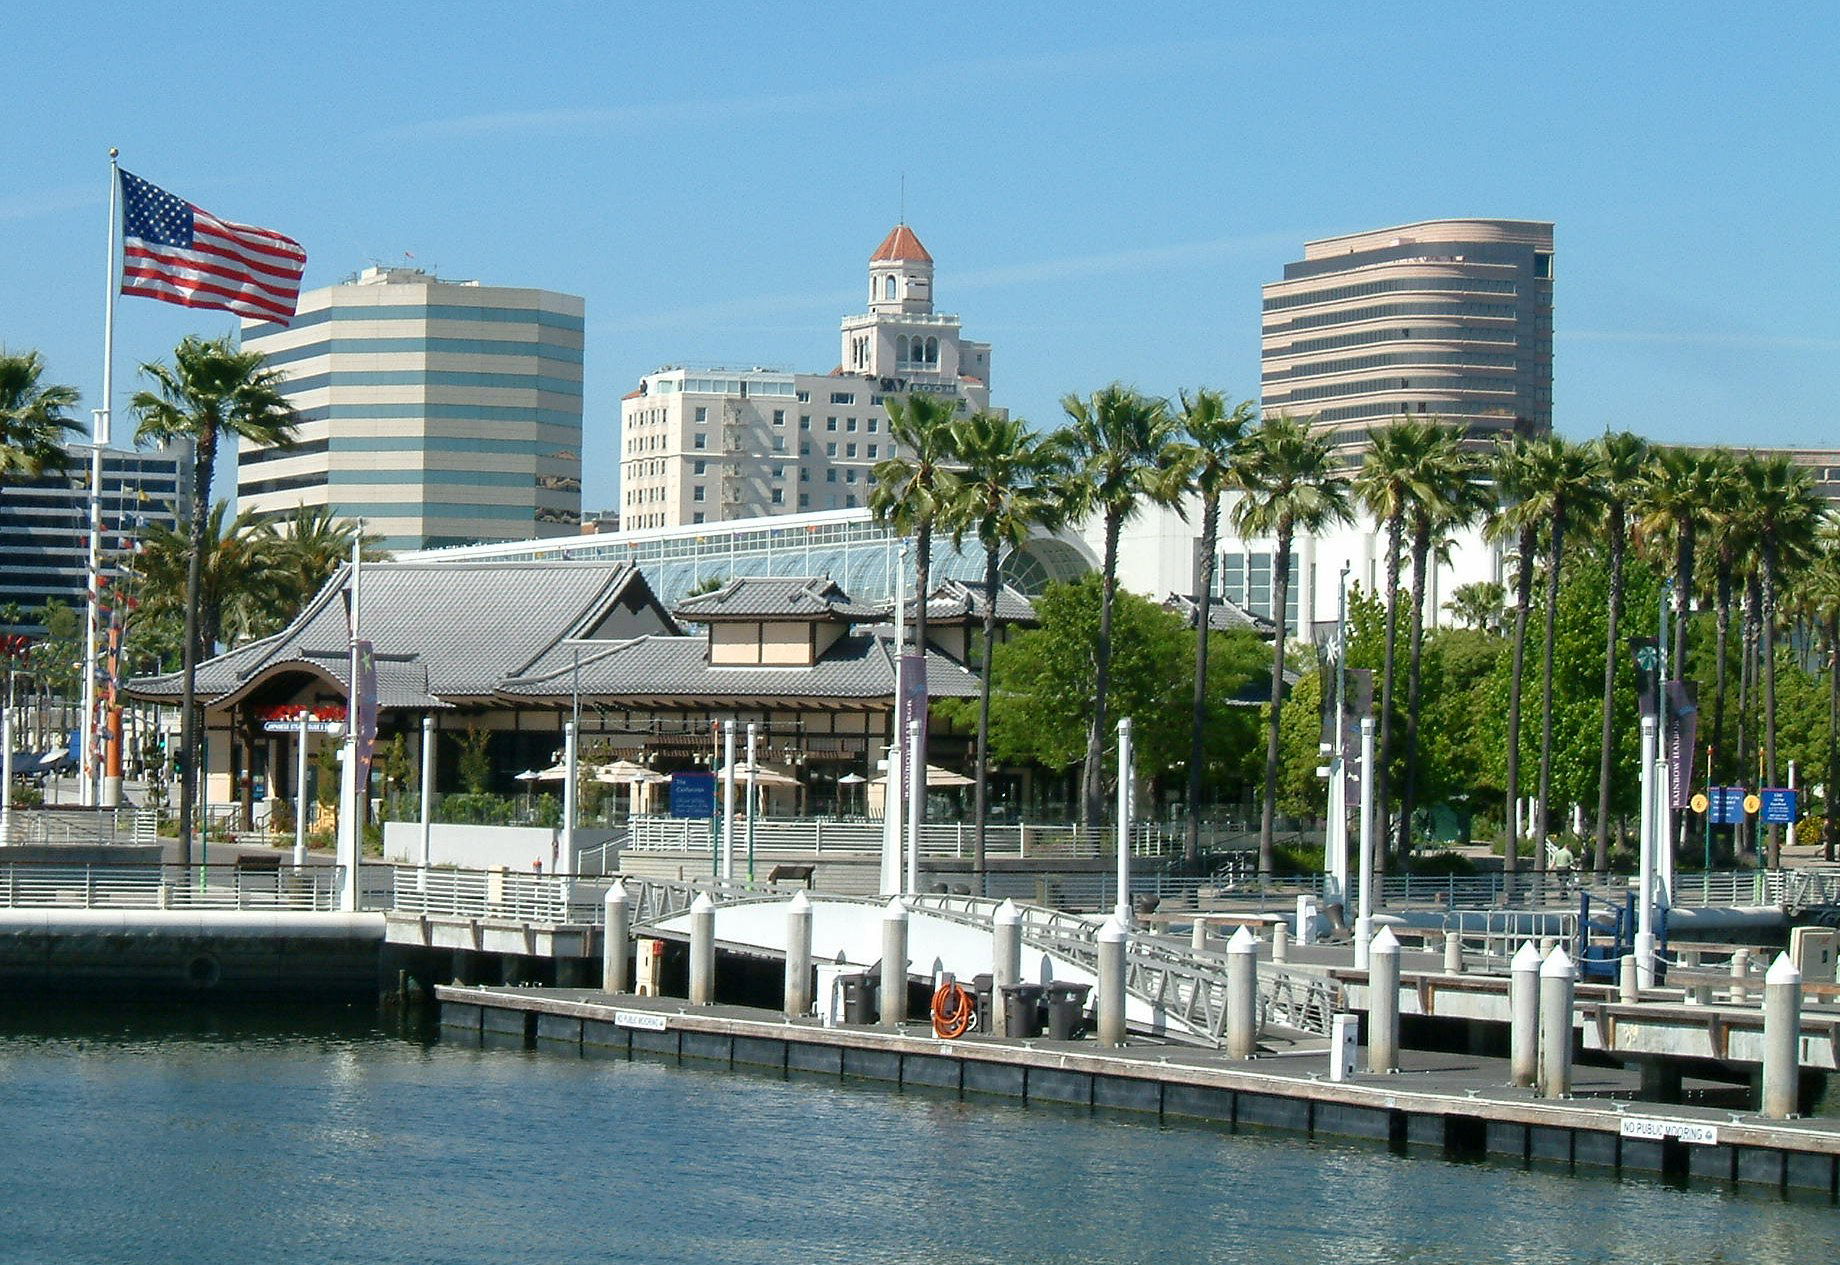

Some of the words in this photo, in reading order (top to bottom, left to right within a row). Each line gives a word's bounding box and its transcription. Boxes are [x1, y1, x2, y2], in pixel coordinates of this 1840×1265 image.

[912, 383, 956, 394] ROOM
[1672, 761, 1681, 807] RAINBOW
[1623, 1121, 1635, 1133] NO
[1636, 1122, 1663, 1136] PUBLIC
[1665, 1125, 1703, 1140] MOORING
